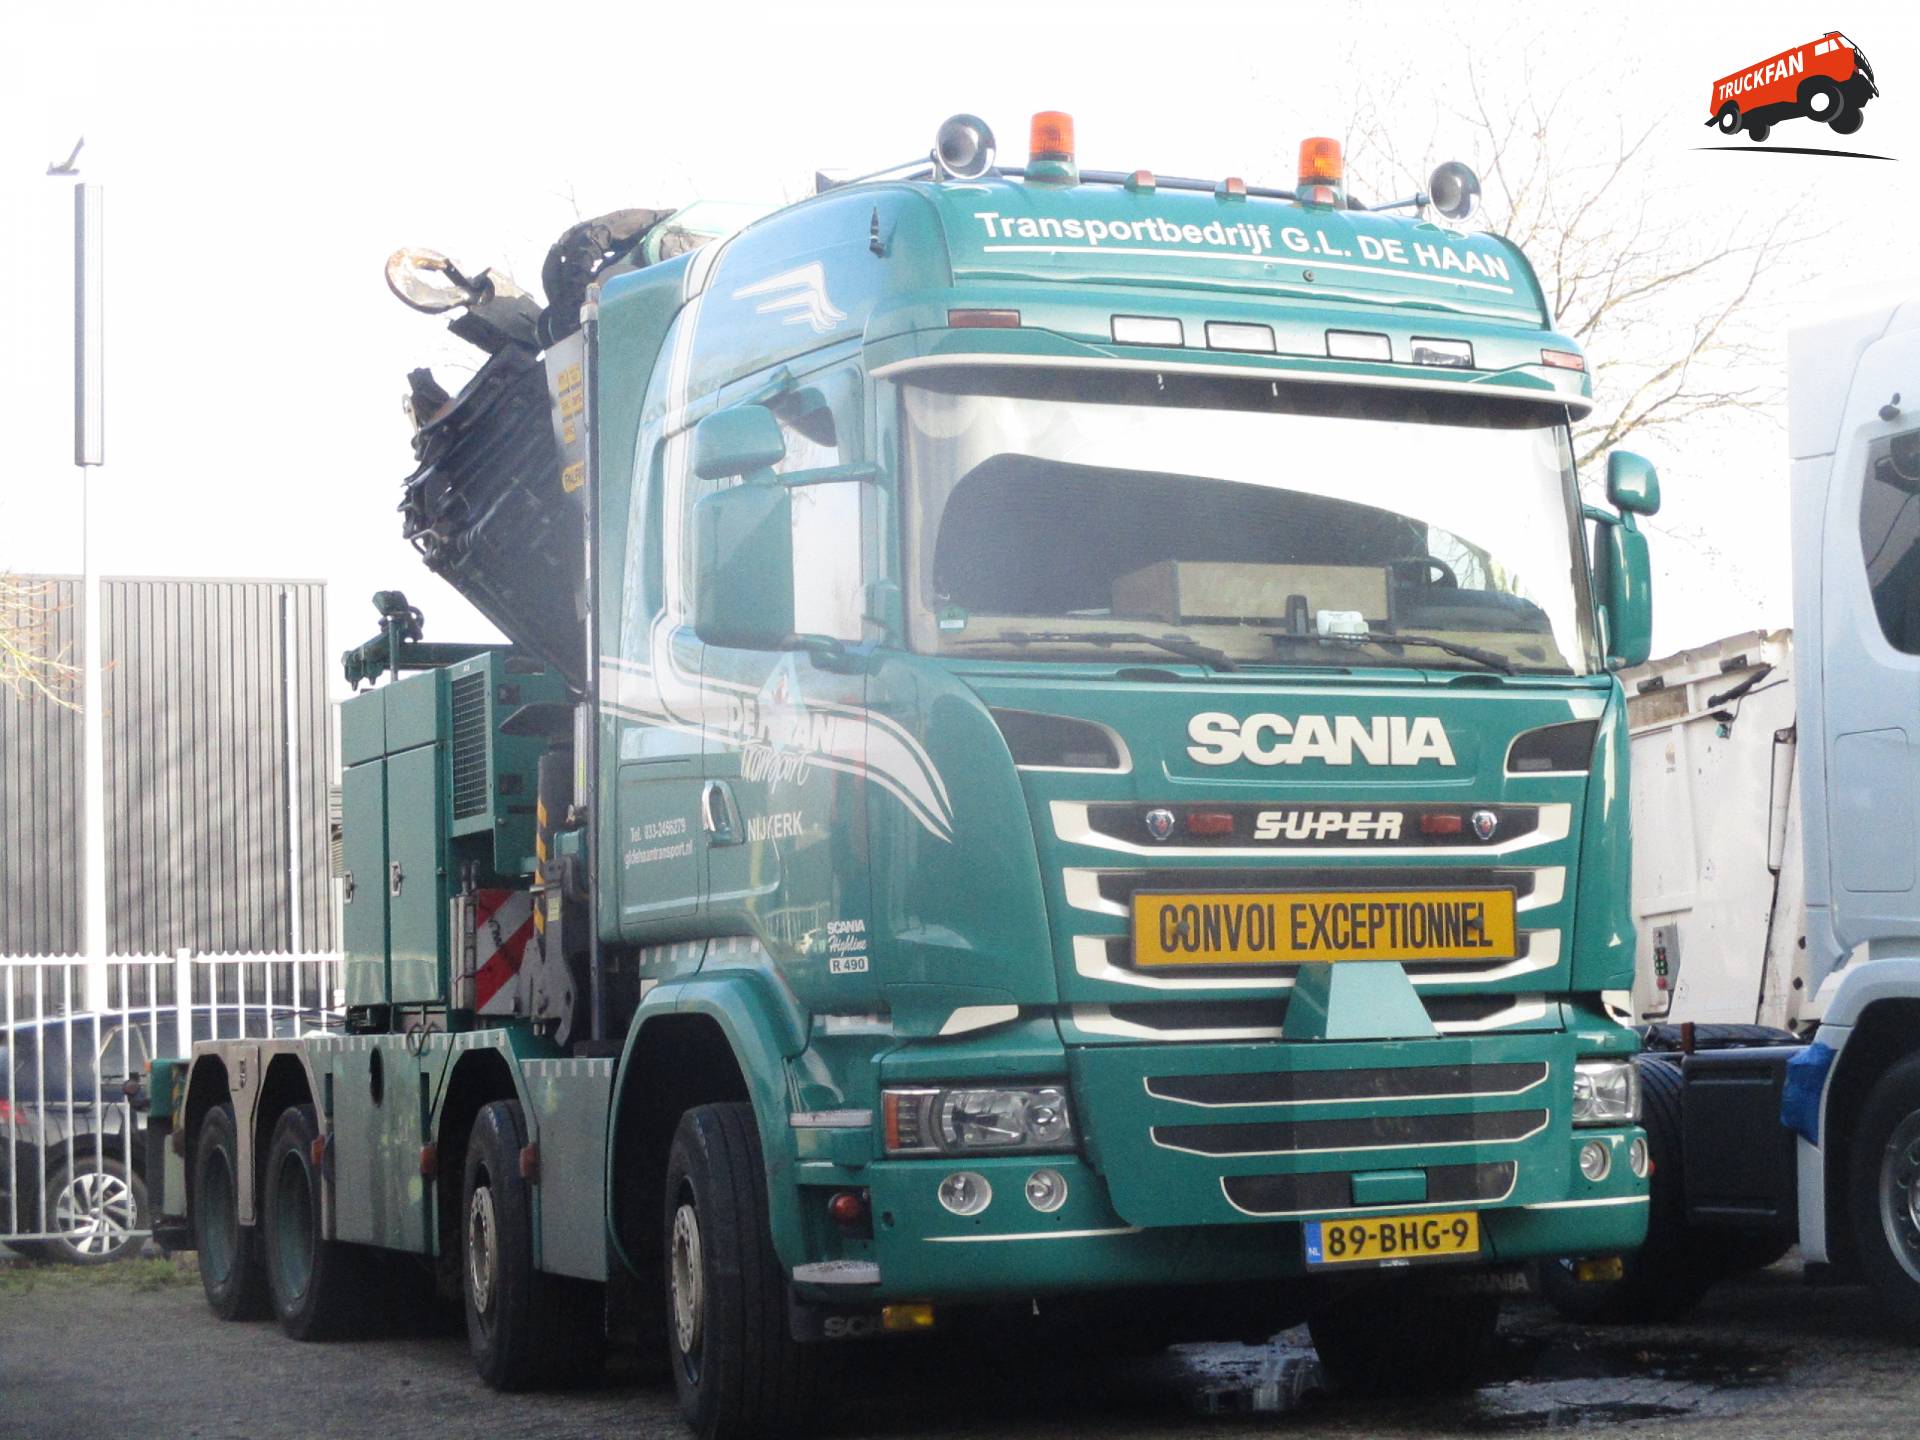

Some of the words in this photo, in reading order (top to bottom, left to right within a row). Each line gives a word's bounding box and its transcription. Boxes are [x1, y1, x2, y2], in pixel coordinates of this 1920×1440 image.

[974, 212, 1271, 254] Transportbedrijf
[1281, 229, 1352, 259] G.L.
[1363, 236, 1409, 264] DE
[1415, 243, 1511, 282] HAAN
[1186, 711, 1457, 766] SCANIA
[747, 810, 802, 842] NIJKERK
[1253, 811, 1404, 840] SUPER
[827, 919, 865, 935] SCANIA
[1159, 902, 1276, 953] CONVOI
[1290, 901, 1494, 951] EXCEPTIONNEL
[832, 960, 841, 972] R
[844, 958, 866, 971] 490
[1308, 1246, 1321, 1256] NL
[1328, 1218, 1470, 1257] 89-BHG-9
